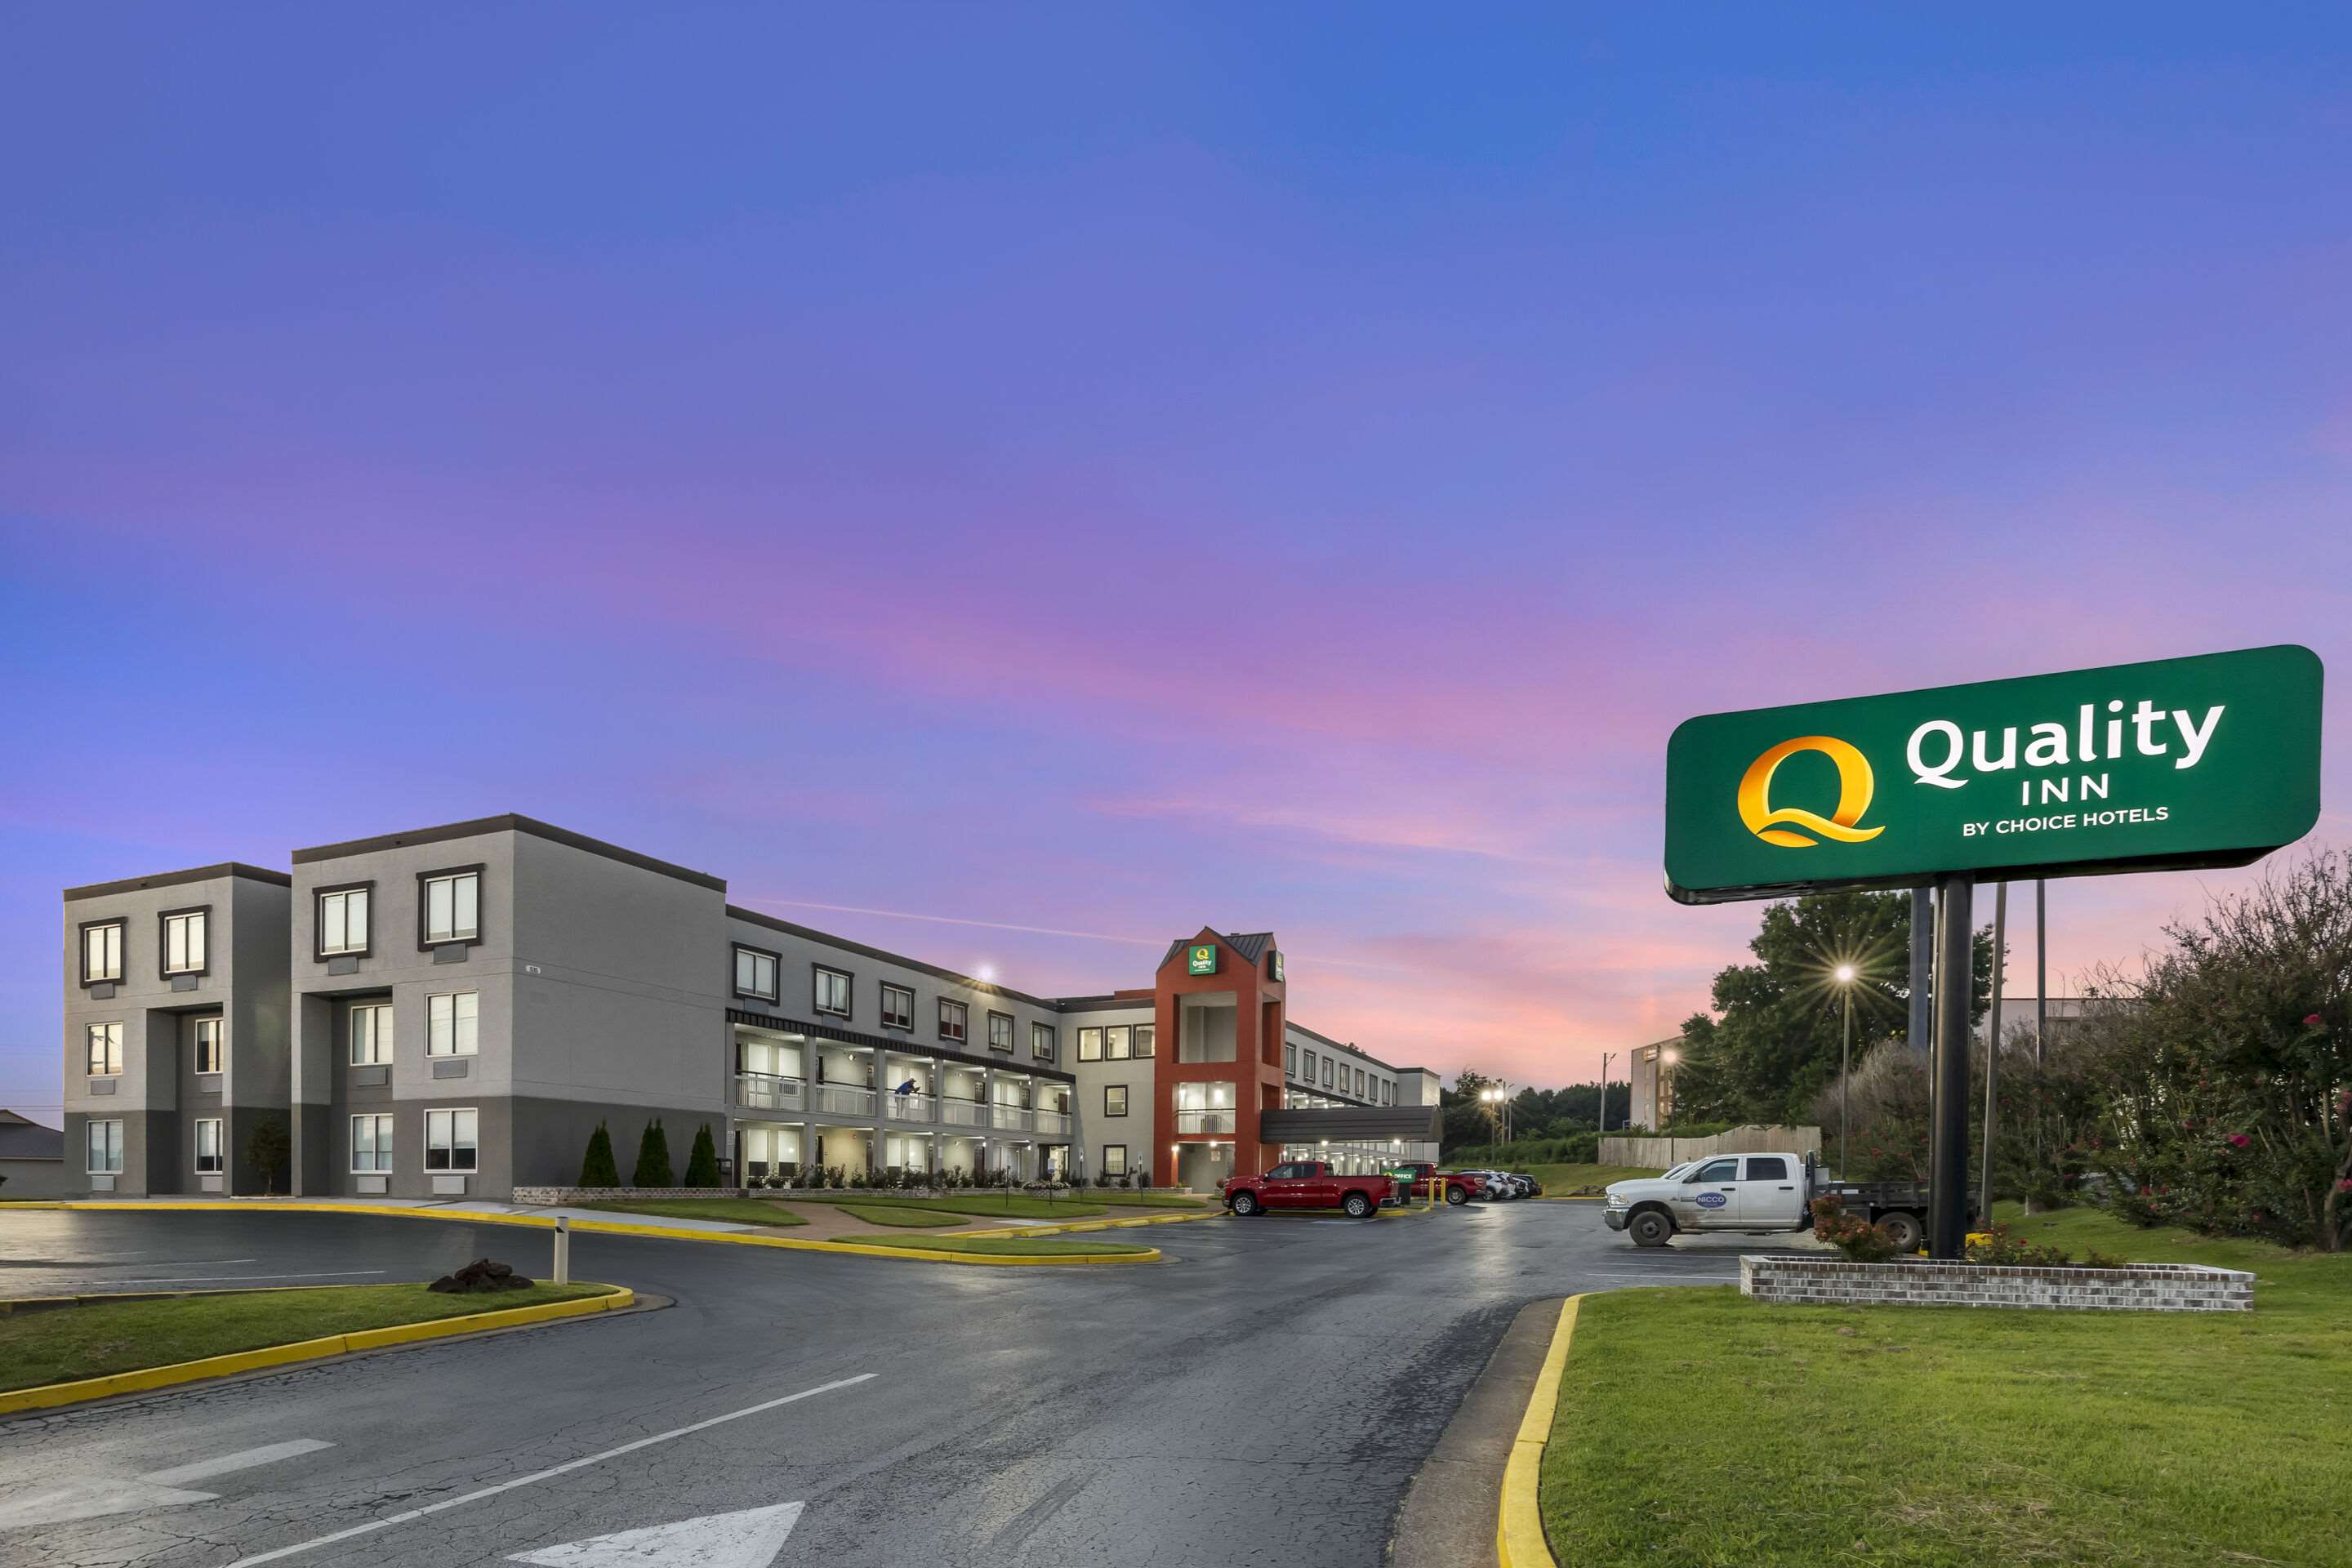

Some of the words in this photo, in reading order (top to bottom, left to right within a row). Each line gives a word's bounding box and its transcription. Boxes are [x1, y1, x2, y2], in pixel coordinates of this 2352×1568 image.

[1906, 699, 2225, 789] Quality
[1737, 735, 1886, 848] Q
[2021, 773, 2109, 806] INN
[1962, 822, 1990, 837] BY
[1995, 813, 2077, 834] CHOICE
[2082, 806, 2170, 826] HOTELS
[1196, 948, 1209, 960] Q
